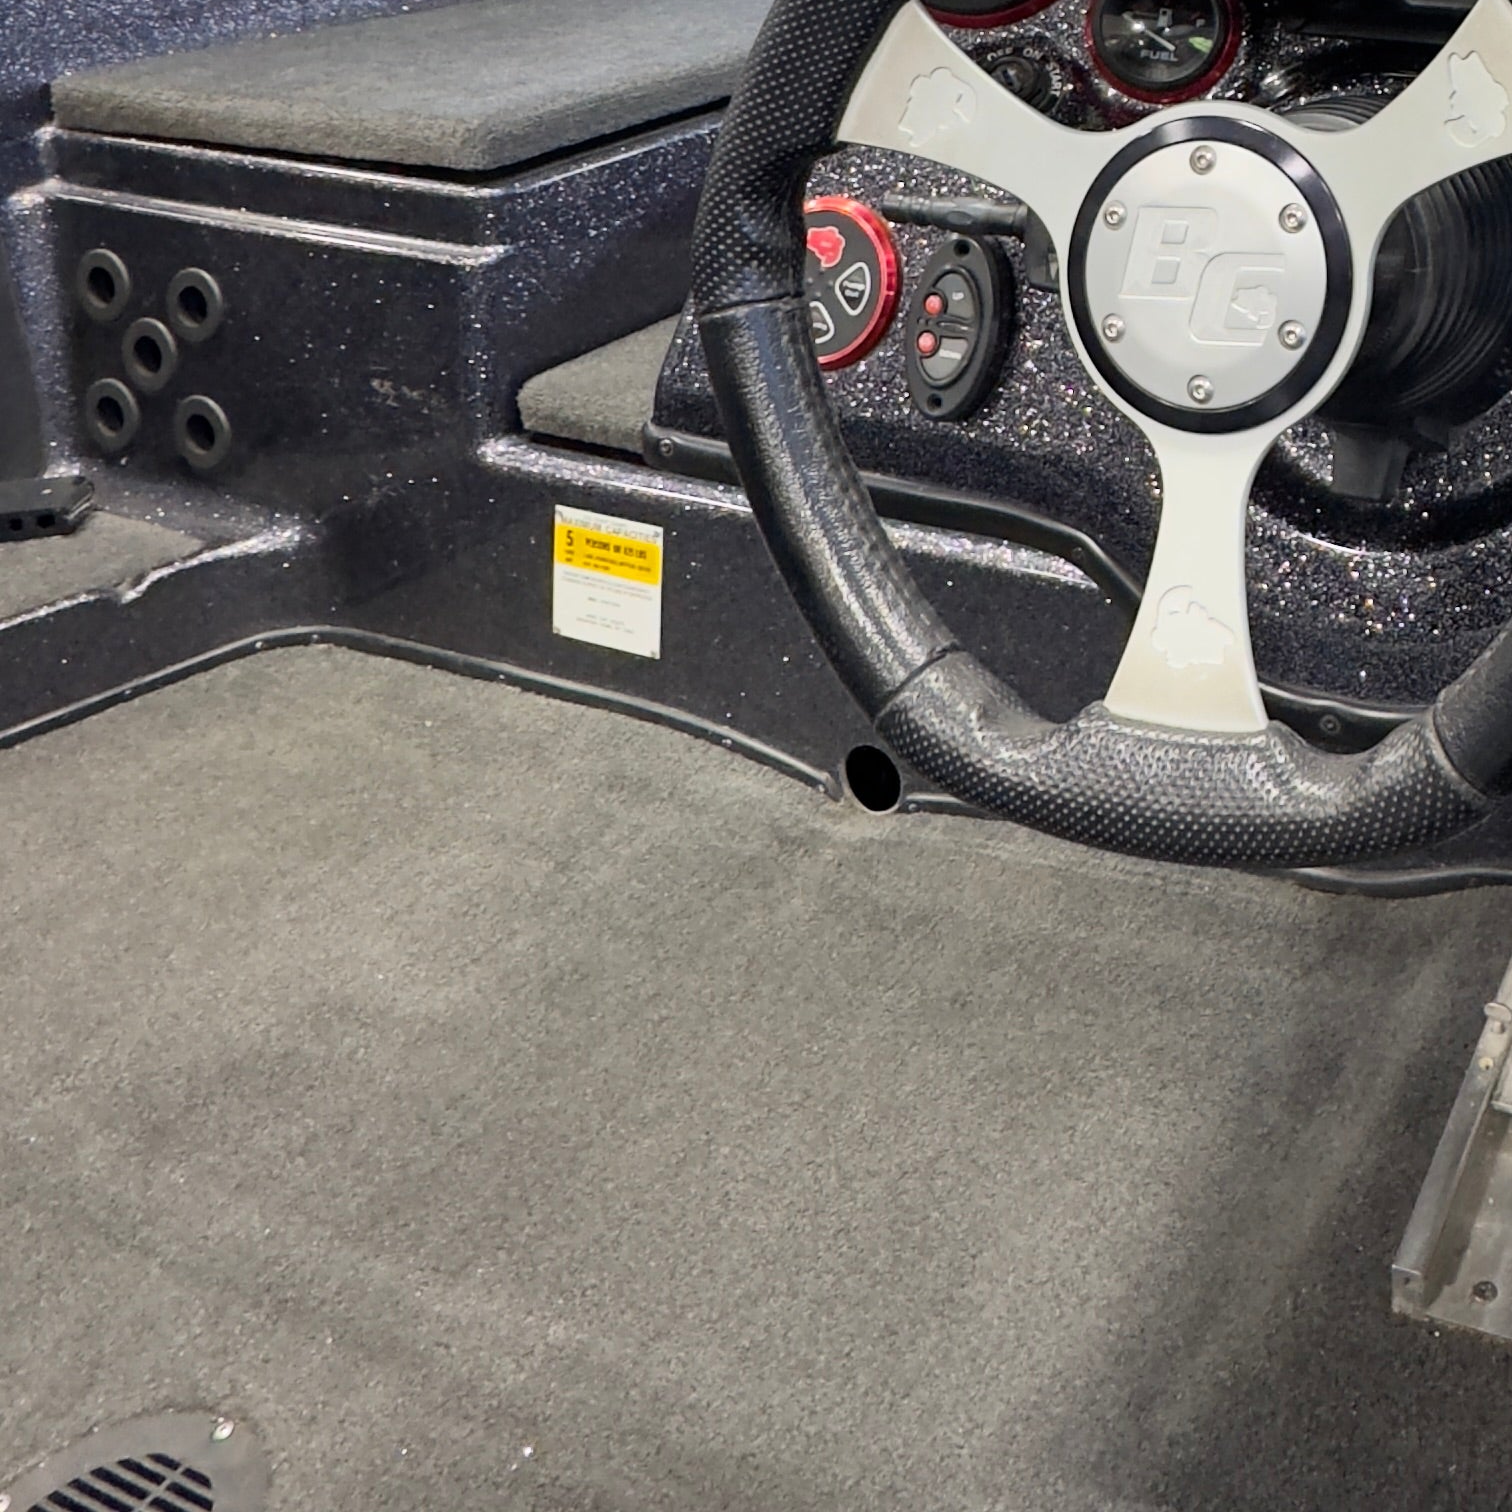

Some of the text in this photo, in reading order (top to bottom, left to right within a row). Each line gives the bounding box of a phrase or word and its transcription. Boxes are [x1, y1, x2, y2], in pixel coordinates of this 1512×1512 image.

[1022, 48, 1043, 60] ON
[1140, 49, 1178, 61] FUEL
[566, 530, 573, 547] 5
